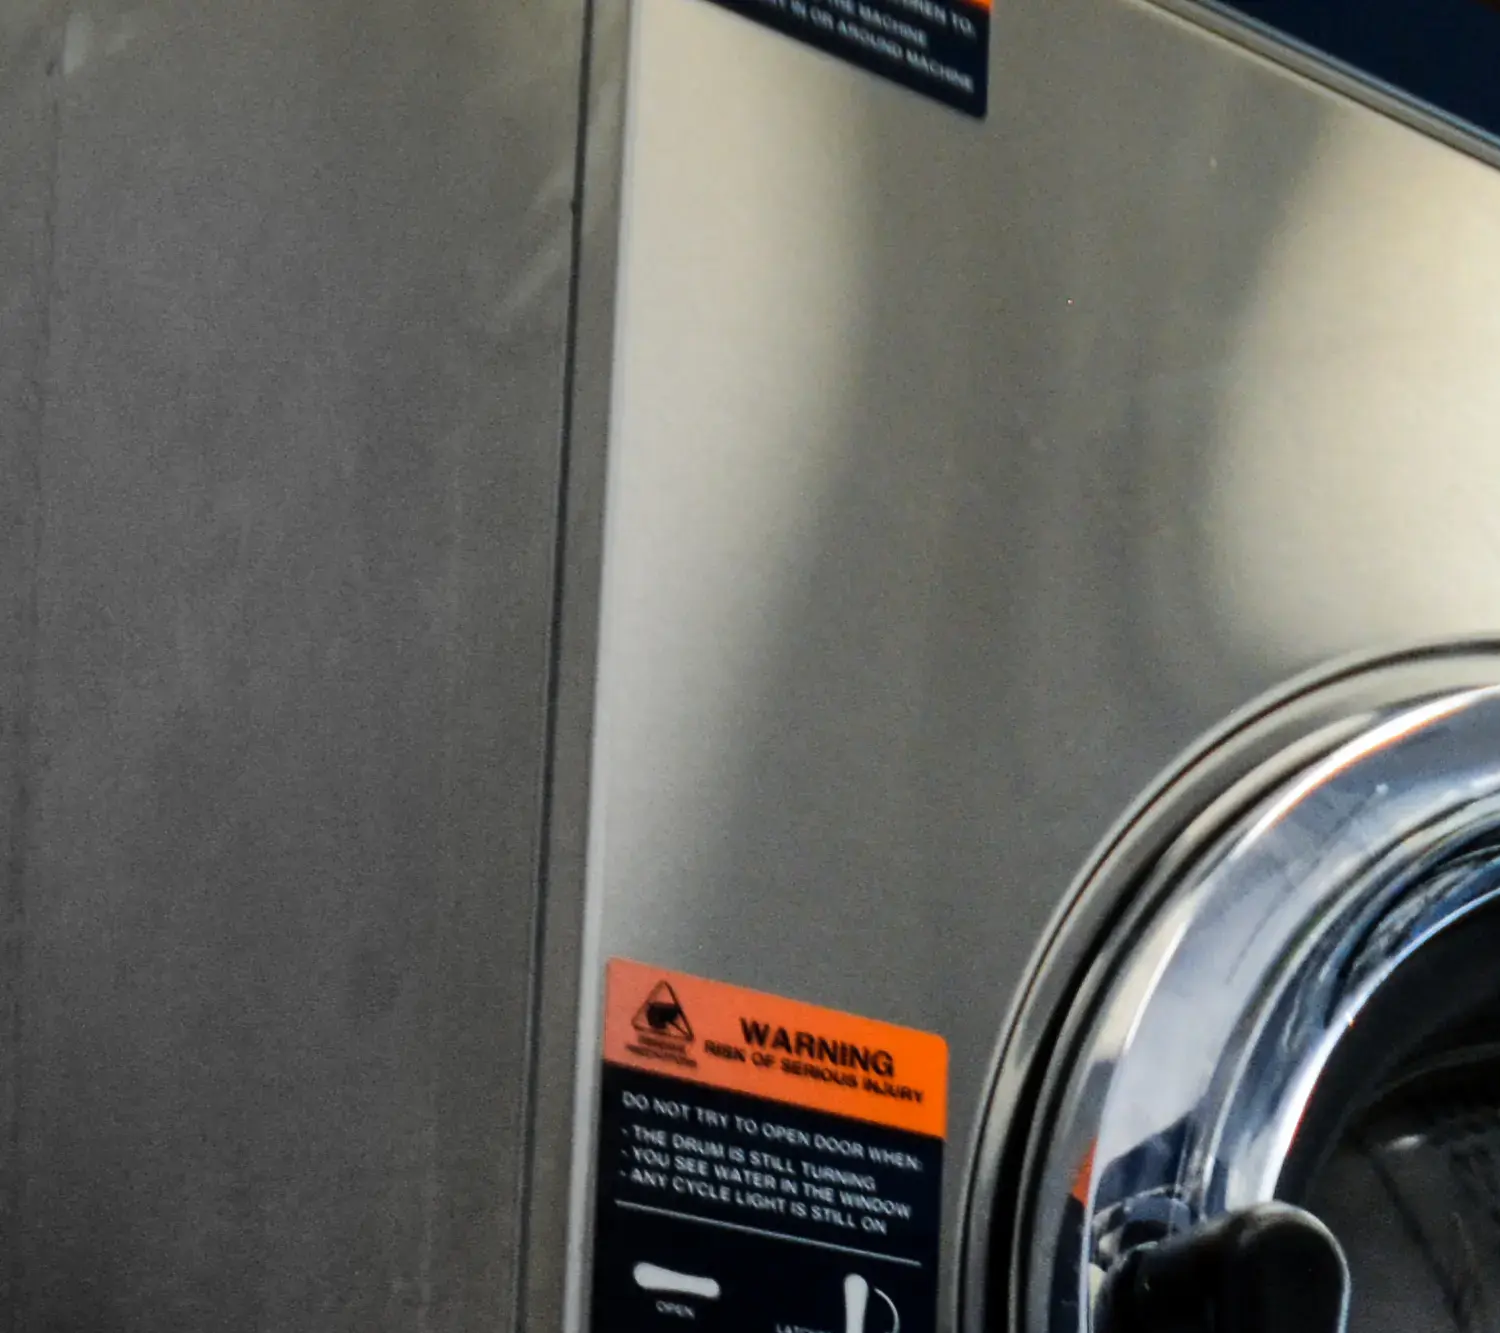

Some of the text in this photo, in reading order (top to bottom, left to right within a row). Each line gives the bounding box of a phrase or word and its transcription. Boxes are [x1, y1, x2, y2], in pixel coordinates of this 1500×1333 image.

[836, 18, 904, 59] AROUND
[906, 46, 975, 94] MACHINE
[857, 2, 928, 49] MACHINE
[704, 1039, 746, 1062] RISK
[752, 1052, 775, 1069] OF
[781, 1058, 858, 1088] SERIOUS
[863, 1077, 924, 1104] INJURY
[740, 1017, 895, 1078] WARNING
[622, 1091, 649, 1110] DO
[653, 1097, 690, 1121] NOT
[695, 1106, 730, 1130] TRY
[735, 1114, 759, 1136] TO
[762, 1121, 810, 1147] OPEN
[814, 1132, 864, 1159] DOOR
[633, 1124, 876, 1193] THE DRUM IS STILL TURNING
[631, 1168, 887, 1235] ANY CYCLE LIGHT IS STILL ON
[634, 1147, 911, 1221] YOU SEE WATER IN THE WINDOW
[656, 1300, 695, 1319] OPEN
